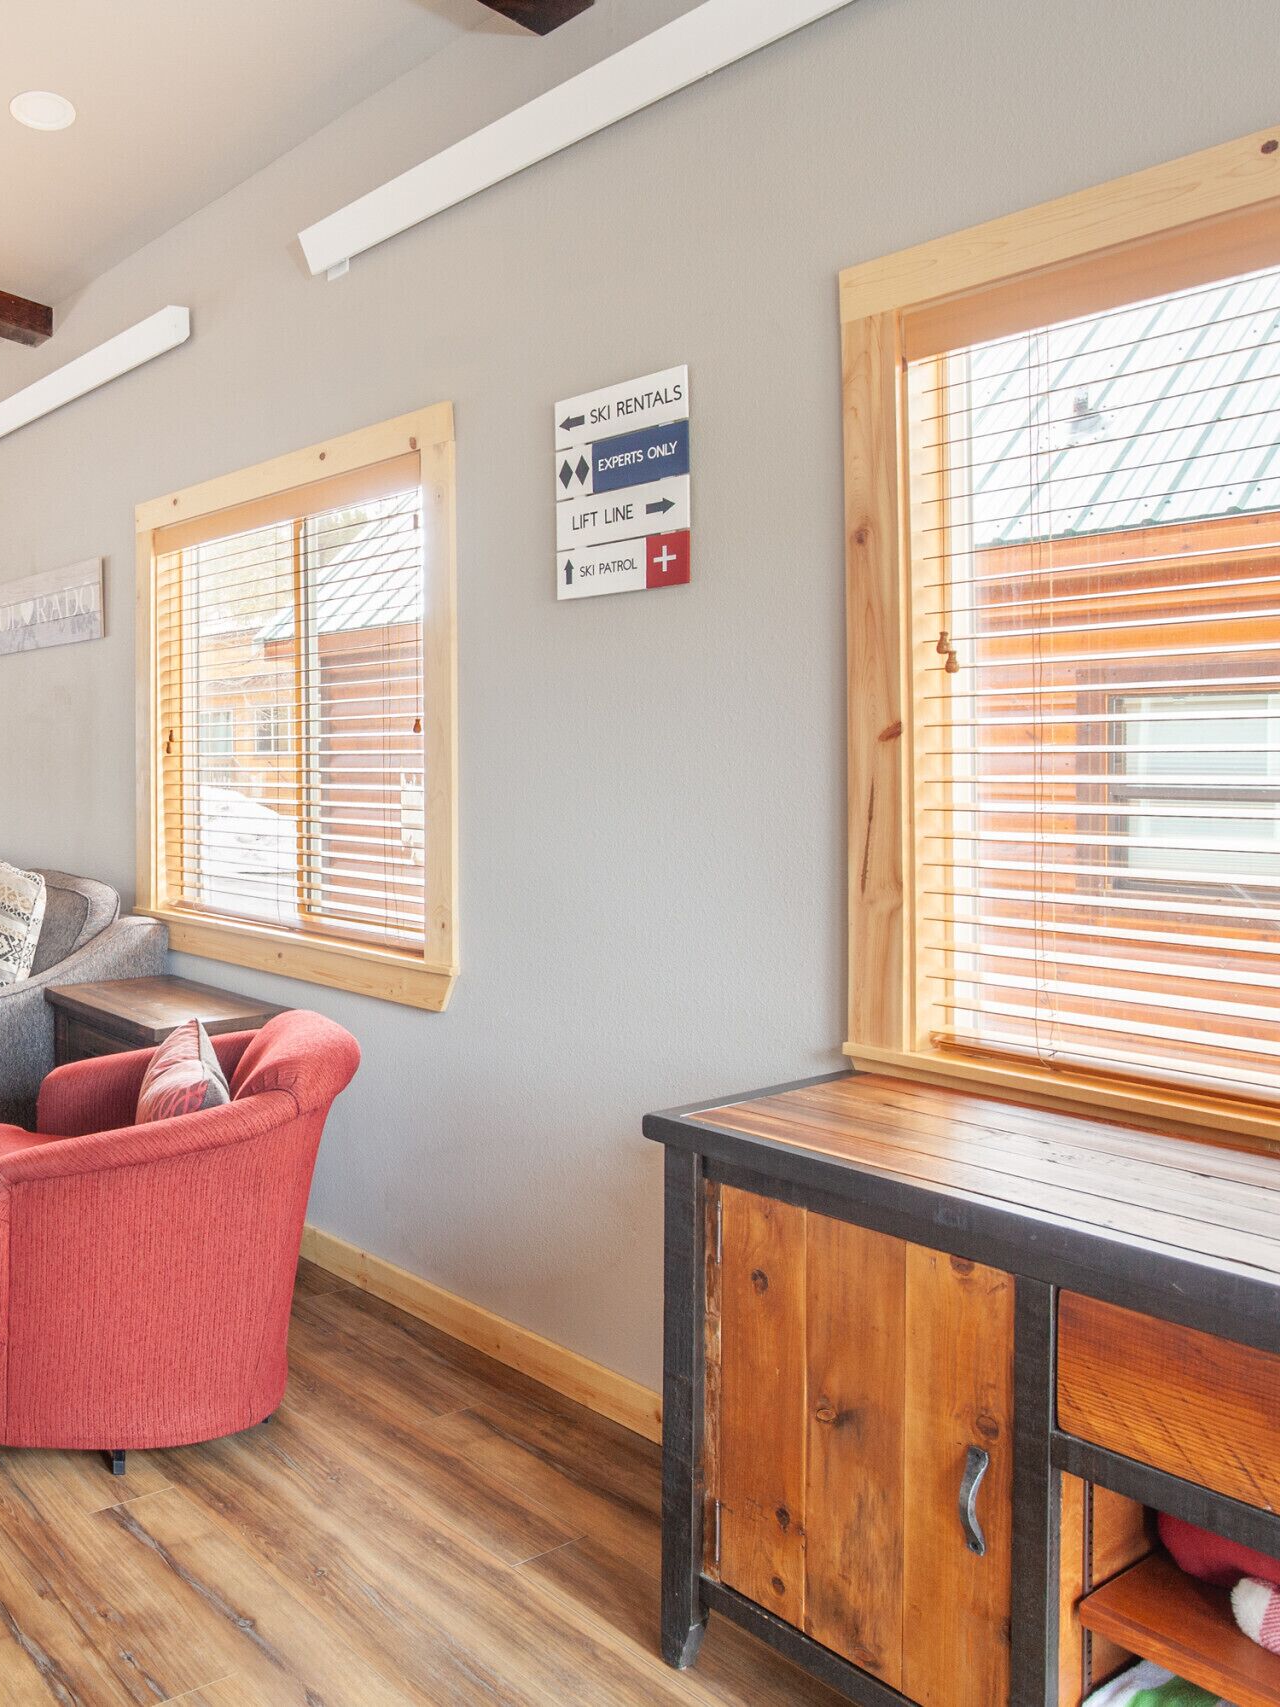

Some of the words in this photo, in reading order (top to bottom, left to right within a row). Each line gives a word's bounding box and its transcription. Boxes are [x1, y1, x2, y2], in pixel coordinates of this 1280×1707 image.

[590, 406, 611, 424] SKI
[617, 385, 682, 416] RENTALS
[598, 449, 644, 472] EXPERTS
[647, 441, 678, 459] ONLY
[572, 510, 598, 531] LIFT
[605, 503, 634, 525] LINE
[579, 563, 595, 578] SKI
[599, 557, 638, 575] PATROL
